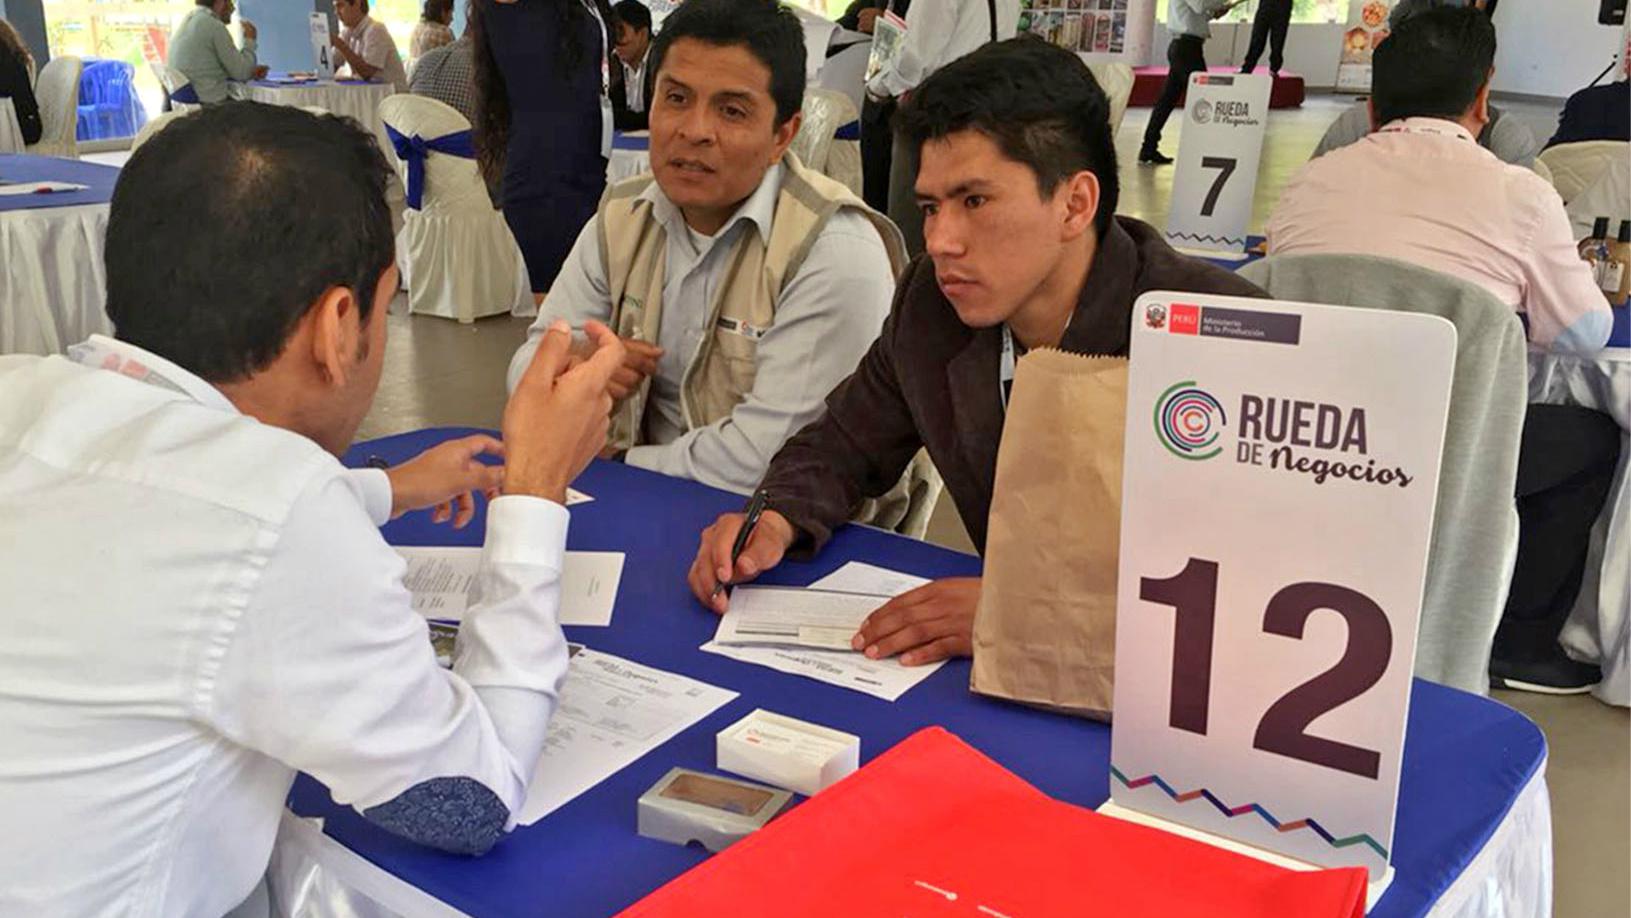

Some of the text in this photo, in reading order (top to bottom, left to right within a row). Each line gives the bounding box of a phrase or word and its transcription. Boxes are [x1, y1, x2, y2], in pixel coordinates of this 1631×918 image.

[320, 45, 328, 69] 4
[1215, 101, 1249, 116] RUEDA
[1200, 156, 1237, 216] 7
[1203, 317, 1242, 327] Ministerio
[1203, 325, 1212, 333] de
[1238, 394, 1368, 454] RUEDA
[1236, 441, 1264, 465] DE
[1140, 557, 1392, 780] 12
